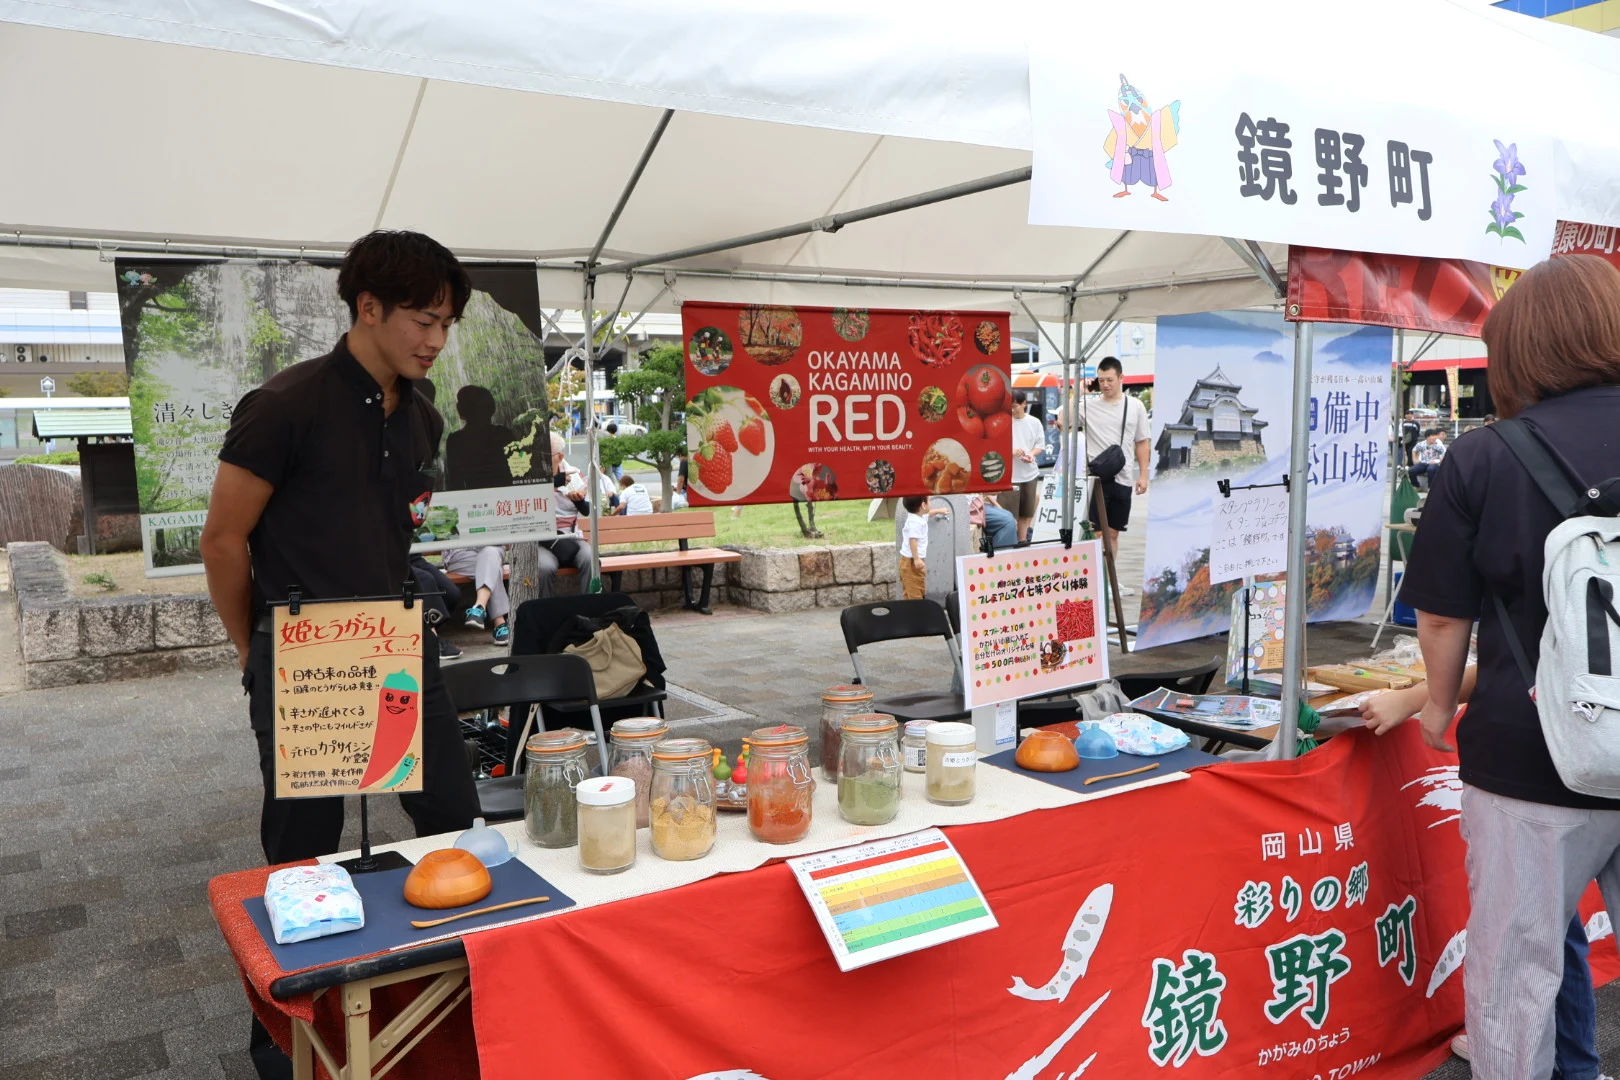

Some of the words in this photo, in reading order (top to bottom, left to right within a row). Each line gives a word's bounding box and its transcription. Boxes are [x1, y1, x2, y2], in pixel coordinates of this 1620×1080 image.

[1235, 112, 1434, 221] 鏡野町
[808, 351, 902, 370] OKAYAMA
[809, 372, 912, 391] KAGAMINO
[154, 401, 233, 423] 清々しき
[809, 394, 913, 443] RED.
[1324, 391, 1380, 435] 備中
[496, 497, 549, 517] 鏡野町
[1220, 498, 1286, 516] スタンプラリーの
[279, 612, 397, 647] 姫とうがらし
[293, 665, 377, 681] 日本古来の品種
[290, 705, 365, 720] 辛さが遅れてくる
[291, 720, 375, 733] 辛さの中にもマイルドさが
[342, 753, 370, 764] が豊富
[1261, 822, 1355, 861] 岡山県
[1234, 861, 1369, 928] 彩りの郷
[1141, 894, 1418, 1068] 鏡野町
[1258, 1027, 1350, 1066] かがみのちょう
[1328, 1052, 1382, 1080] TOWN
